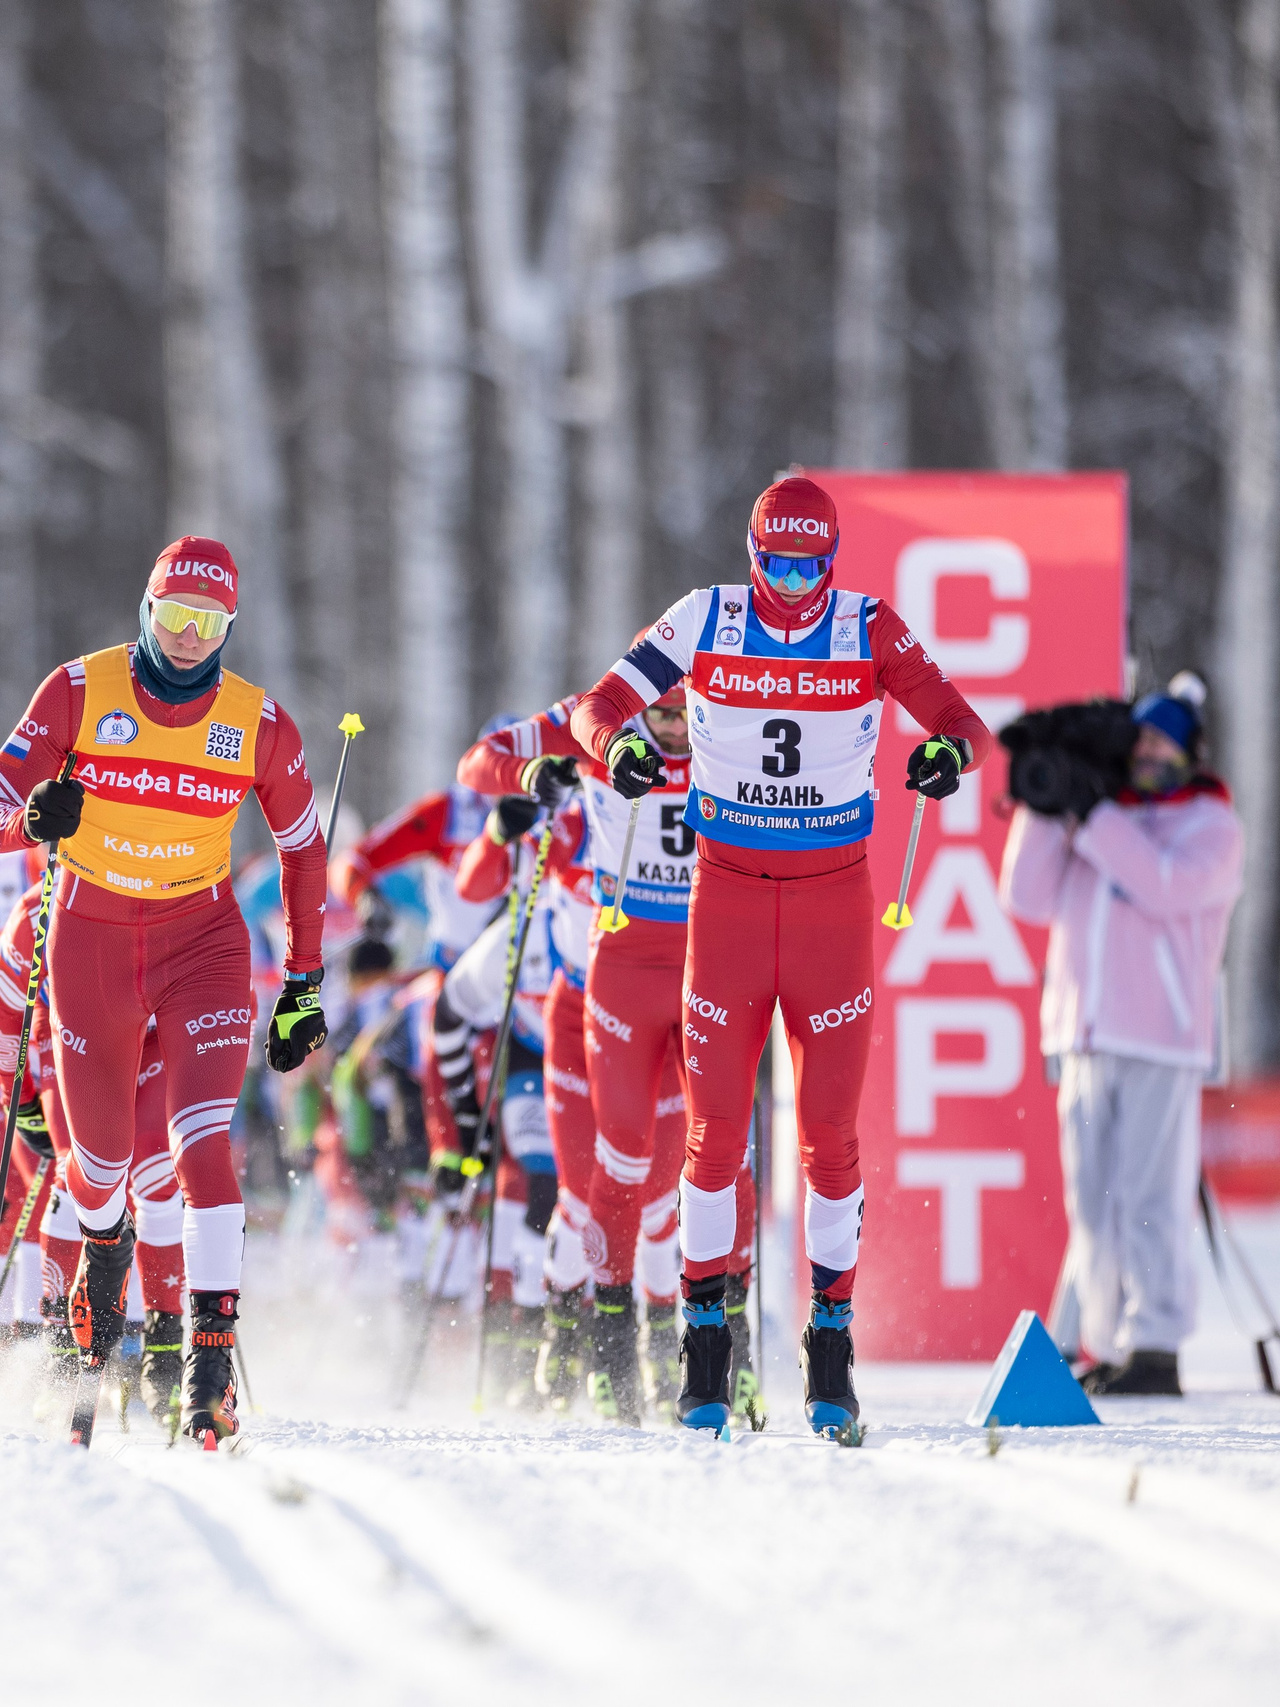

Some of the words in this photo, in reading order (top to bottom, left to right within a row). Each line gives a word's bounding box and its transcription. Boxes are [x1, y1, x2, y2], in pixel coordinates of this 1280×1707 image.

[765, 517, 829, 539] LUKOIL
[165, 561, 234, 593] LUKOIL
[707, 666, 792, 699] Альфа
[797, 672, 862, 696] Банк
[208, 732, 242, 748] 2023
[210, 722, 243, 738] СЕЗОН
[206, 744, 240, 761] 2024
[761, 718, 802, 778] 3
[78, 762, 170, 795] Альфа
[176, 773, 242, 804] Банк
[736, 781, 824, 807] КАЗАНЬ
[721, 808, 801, 830] РЕСПУБЛИКА
[804, 806, 861, 829] ТАТАРСТАН
[661, 804, 697, 858] 5
[103, 835, 195, 859] КАЗАНЬ
[106, 870, 142, 892] BOSCO
[637, 861, 692, 884] КАЗА
[185, 1008, 250, 1036] BOSCO
[808, 986, 872, 1035] BOSCO
[196, 1037, 231, 1054] Альфа
